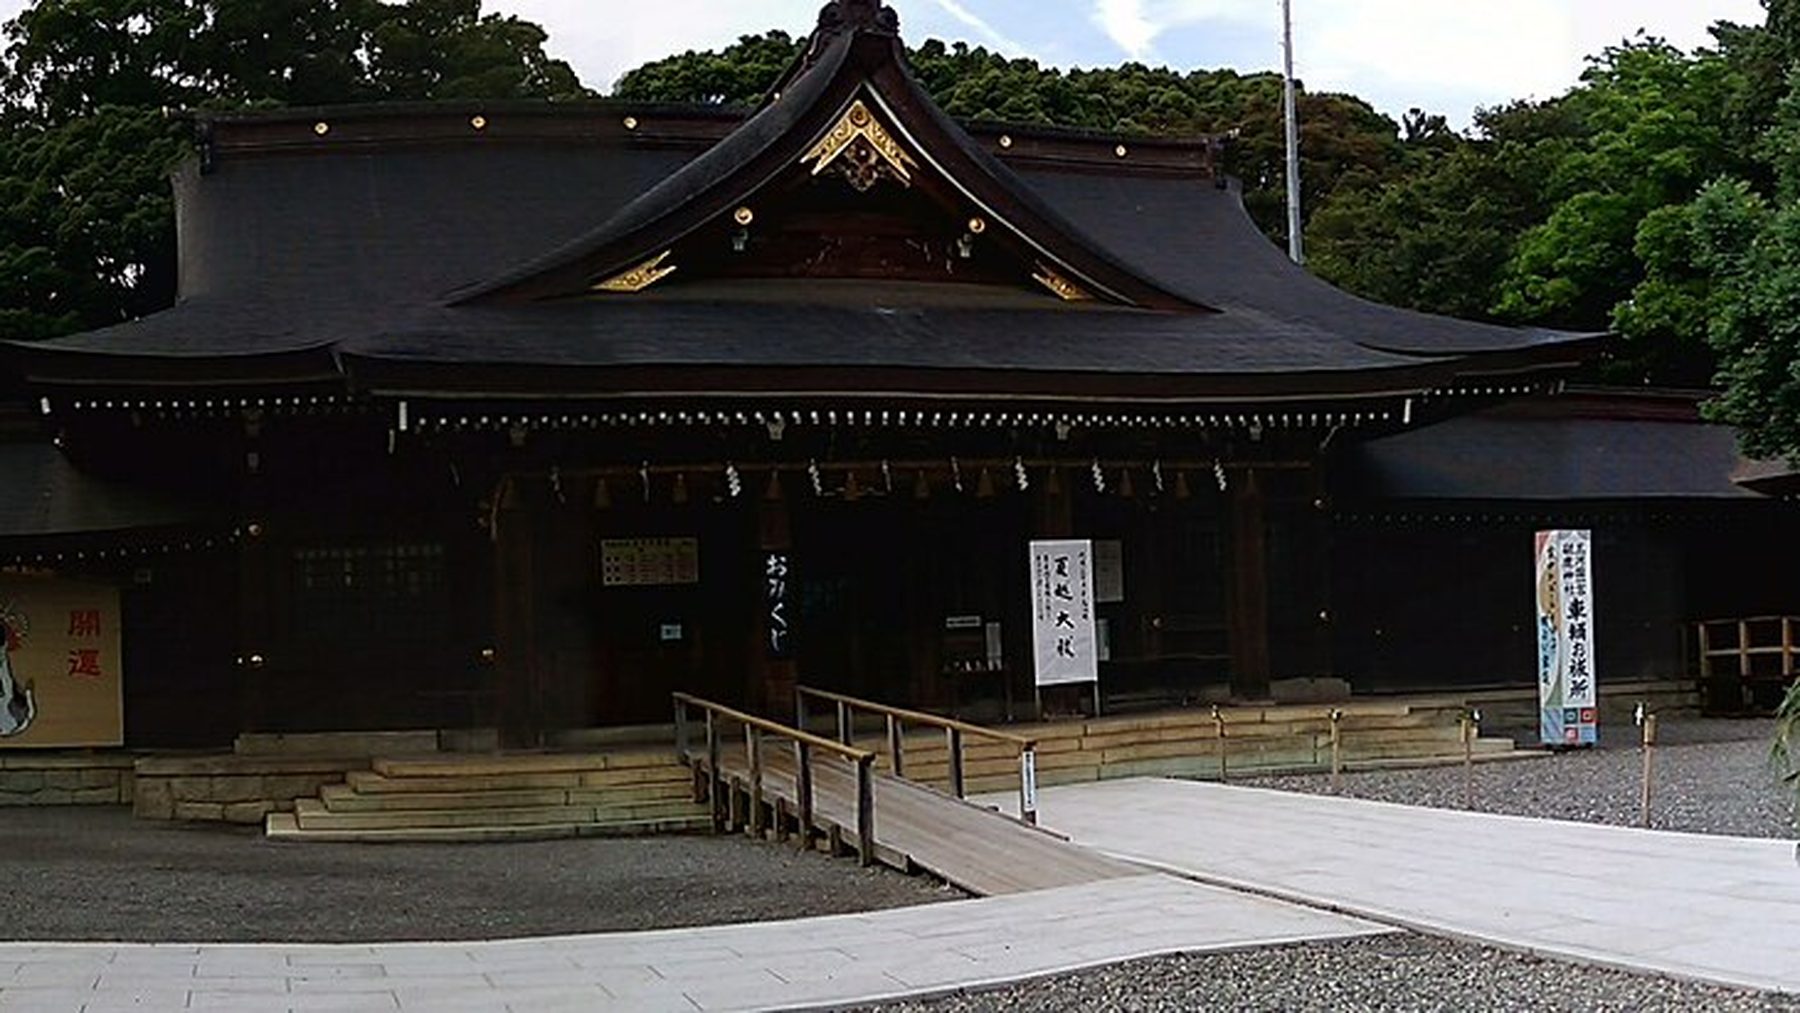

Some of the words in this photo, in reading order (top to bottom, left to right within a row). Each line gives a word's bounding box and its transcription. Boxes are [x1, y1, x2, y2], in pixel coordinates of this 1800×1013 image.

[67, 609, 102, 677] 開運
[765, 553, 789, 653] おみくじ
